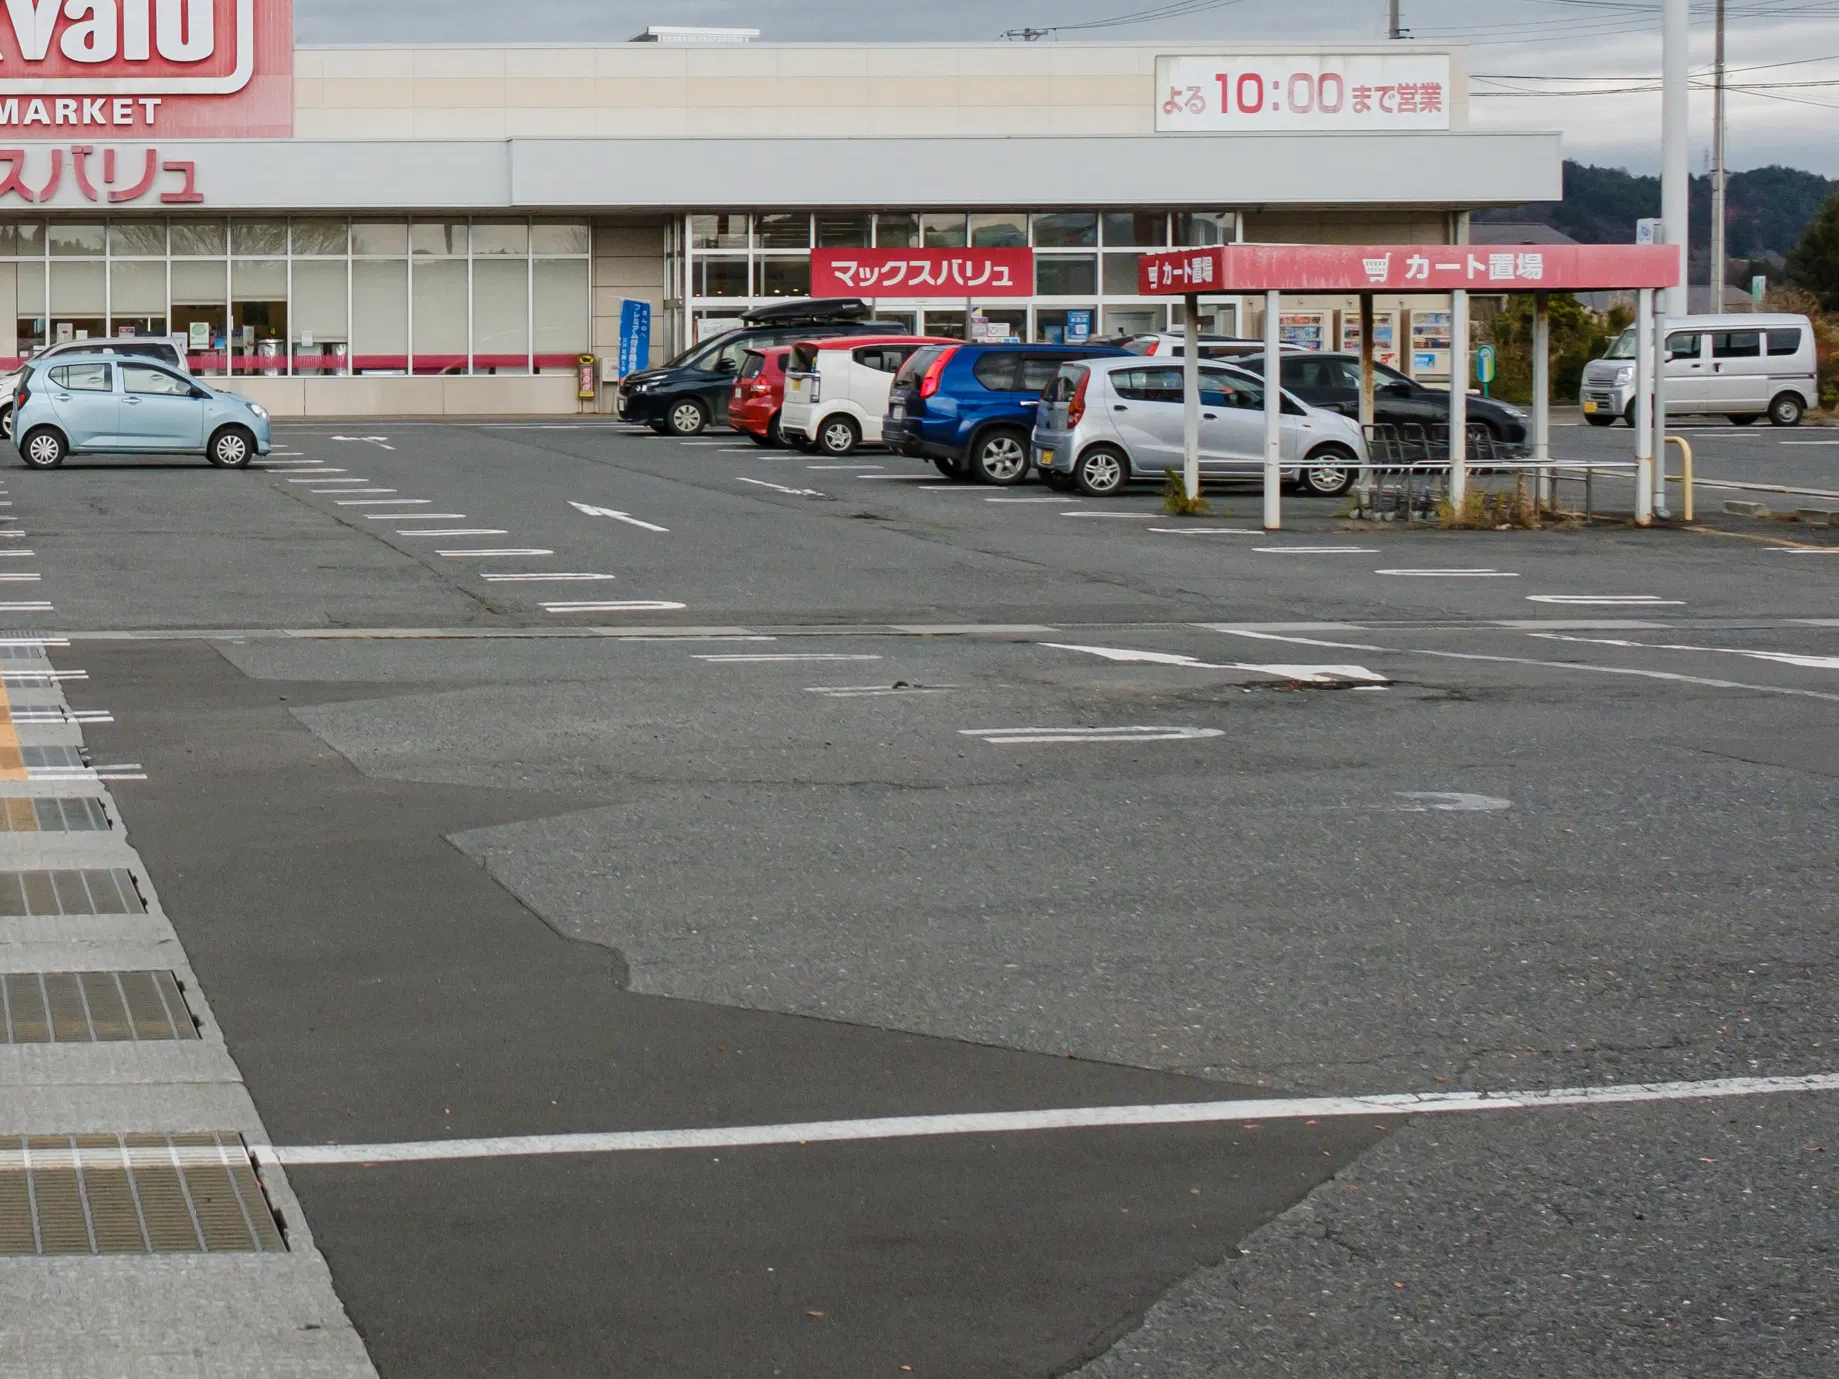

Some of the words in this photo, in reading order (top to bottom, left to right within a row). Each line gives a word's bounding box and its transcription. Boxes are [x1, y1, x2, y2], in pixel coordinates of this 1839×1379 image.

[831, 259, 1013, 287] マックスバリュ
[1162, 256, 1214, 286] カート置場
[1405, 253, 1543, 281] カート置場
